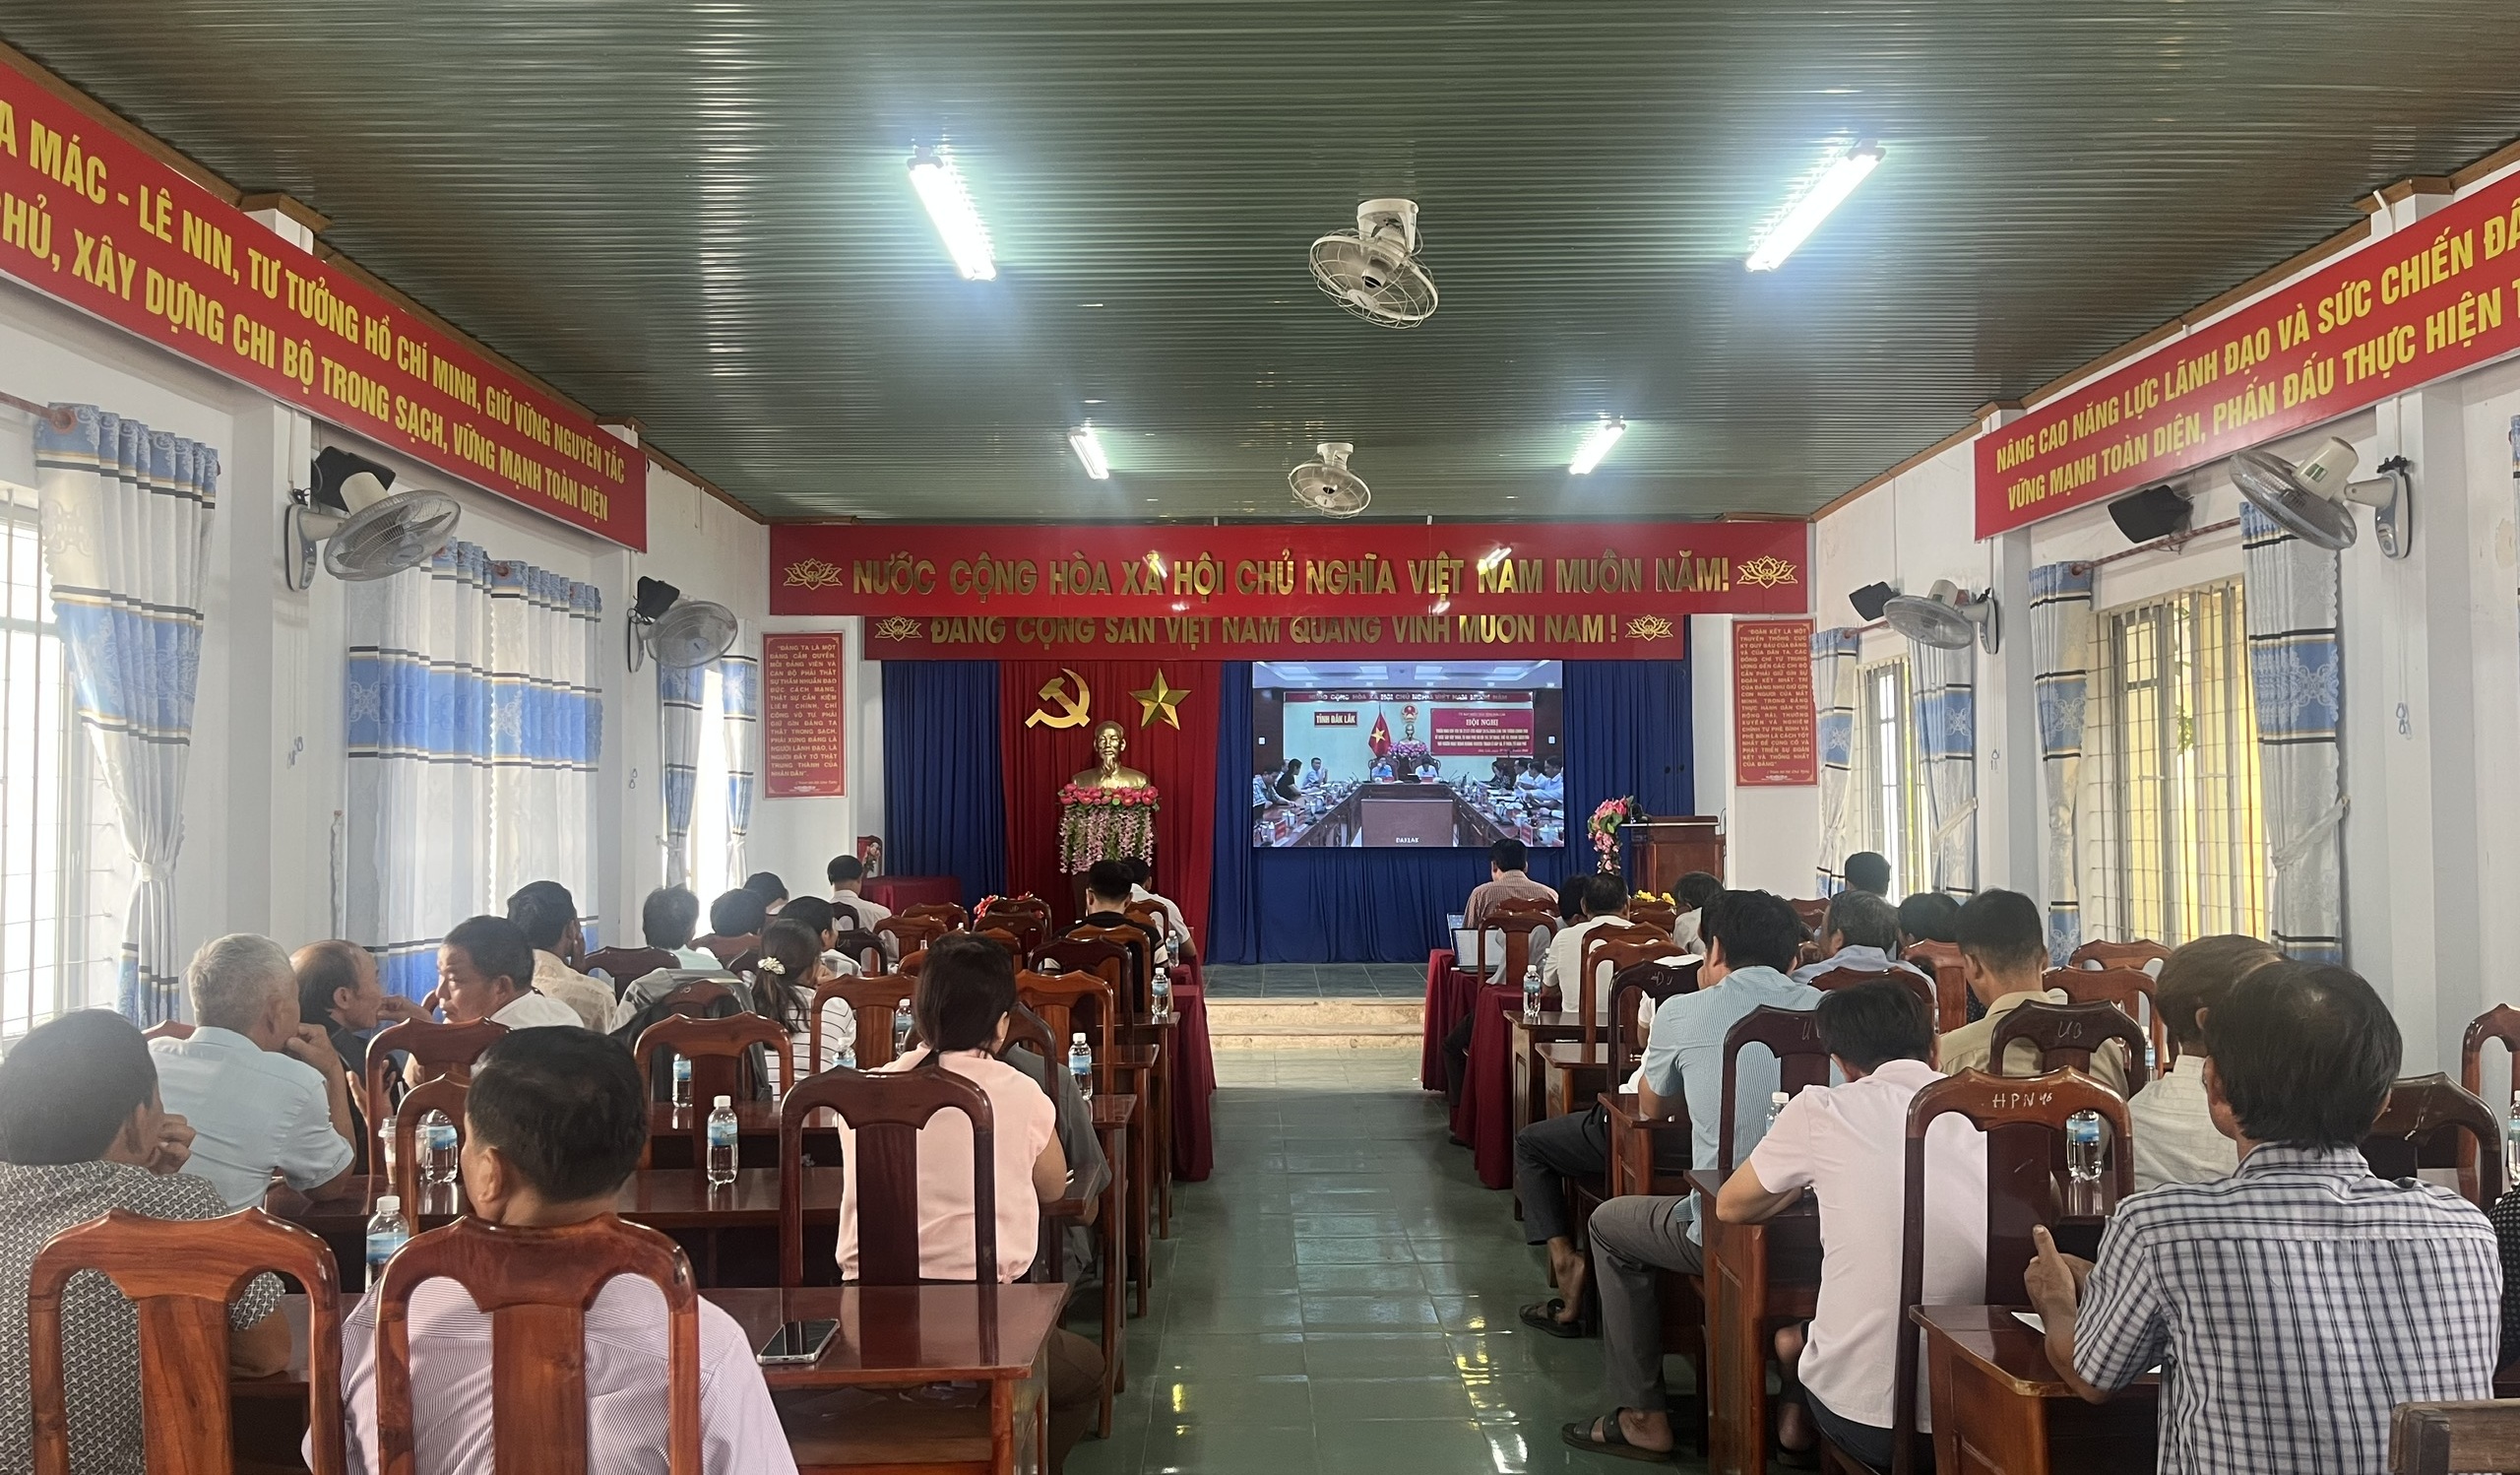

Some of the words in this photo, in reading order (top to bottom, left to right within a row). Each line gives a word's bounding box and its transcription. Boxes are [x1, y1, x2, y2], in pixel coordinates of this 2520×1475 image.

[0, 192, 60, 272] HỦ,
[72, 227, 137, 301] XÂY
[146, 267, 224, 345] DỰNG
[233, 313, 275, 369] CHI
[284, 337, 315, 394] BỘ
[322, 356, 389, 422] TRONG
[396, 395, 448, 454] SẠCH,
[454, 421, 495, 472] VỮNG
[500, 446, 541, 491] MẠNH
[545, 470, 578, 508] TOÀN
[581, 485, 608, 523] DIỆN
[30, 118, 107, 204] MÁC
[117, 193, 129, 206] -
[139, 184, 172, 243] LÊ
[182, 210, 239, 285] NIN,
[248, 248, 281, 298] TƯ
[285, 269, 358, 344] TƯỞNG
[365, 314, 391, 360] HỒ
[398, 336, 427, 382] CHÍ
[433, 355, 481, 414] MINH,
[486, 386, 513, 425] GIỮ
[515, 402, 550, 446] VỮNG
[554, 426, 601, 473] NGUYÊN
[604, 445, 625, 484] TẮC
[1996, 434, 2035, 474] NÂNG
[2040, 418, 2067, 455] CAO
[2073, 396, 2118, 441] NĂNG
[2124, 378, 2159, 419] LỰC
[2165, 350, 2218, 401] LÃNH
[2224, 327, 2270, 375] ĐẠO
[2278, 303, 2310, 352] VÀ
[2318, 280, 2371, 334] SỨC
[2381, 226, 2473, 305] CHIẾN
[2008, 475, 2046, 511] VỮNG
[2049, 453, 2097, 496] MẠNH
[2102, 433, 2148, 477] TOÀN
[2154, 413, 2206, 458] DIỆN,
[2213, 376, 2276, 436] PHẤN
[2283, 352, 2334, 410] ĐẤU
[2342, 325, 2416, 386] THỰC
[2426, 287, 2501, 354] HIỆN
[853, 551, 936, 595] NƯỚC
[950, 551, 1038, 604] CỘNG
[1049, 551, 1112, 596] HÒA
[1173, 551, 1224, 604] HỘI
[1235, 548, 1295, 595] CHỦ
[1306, 553, 1397, 595] NGHĨA
[1408, 551, 1465, 602] VIỆT
[1479, 558, 1543, 594] NAM
[1556, 549, 1643, 594] MUÔN
[1656, 550, 1730, 592] NĂM!
[1223, 616, 1280, 644] NAM
[1290, 616, 1381, 645] QUANG
[1392, 615, 1450, 644] VINH
